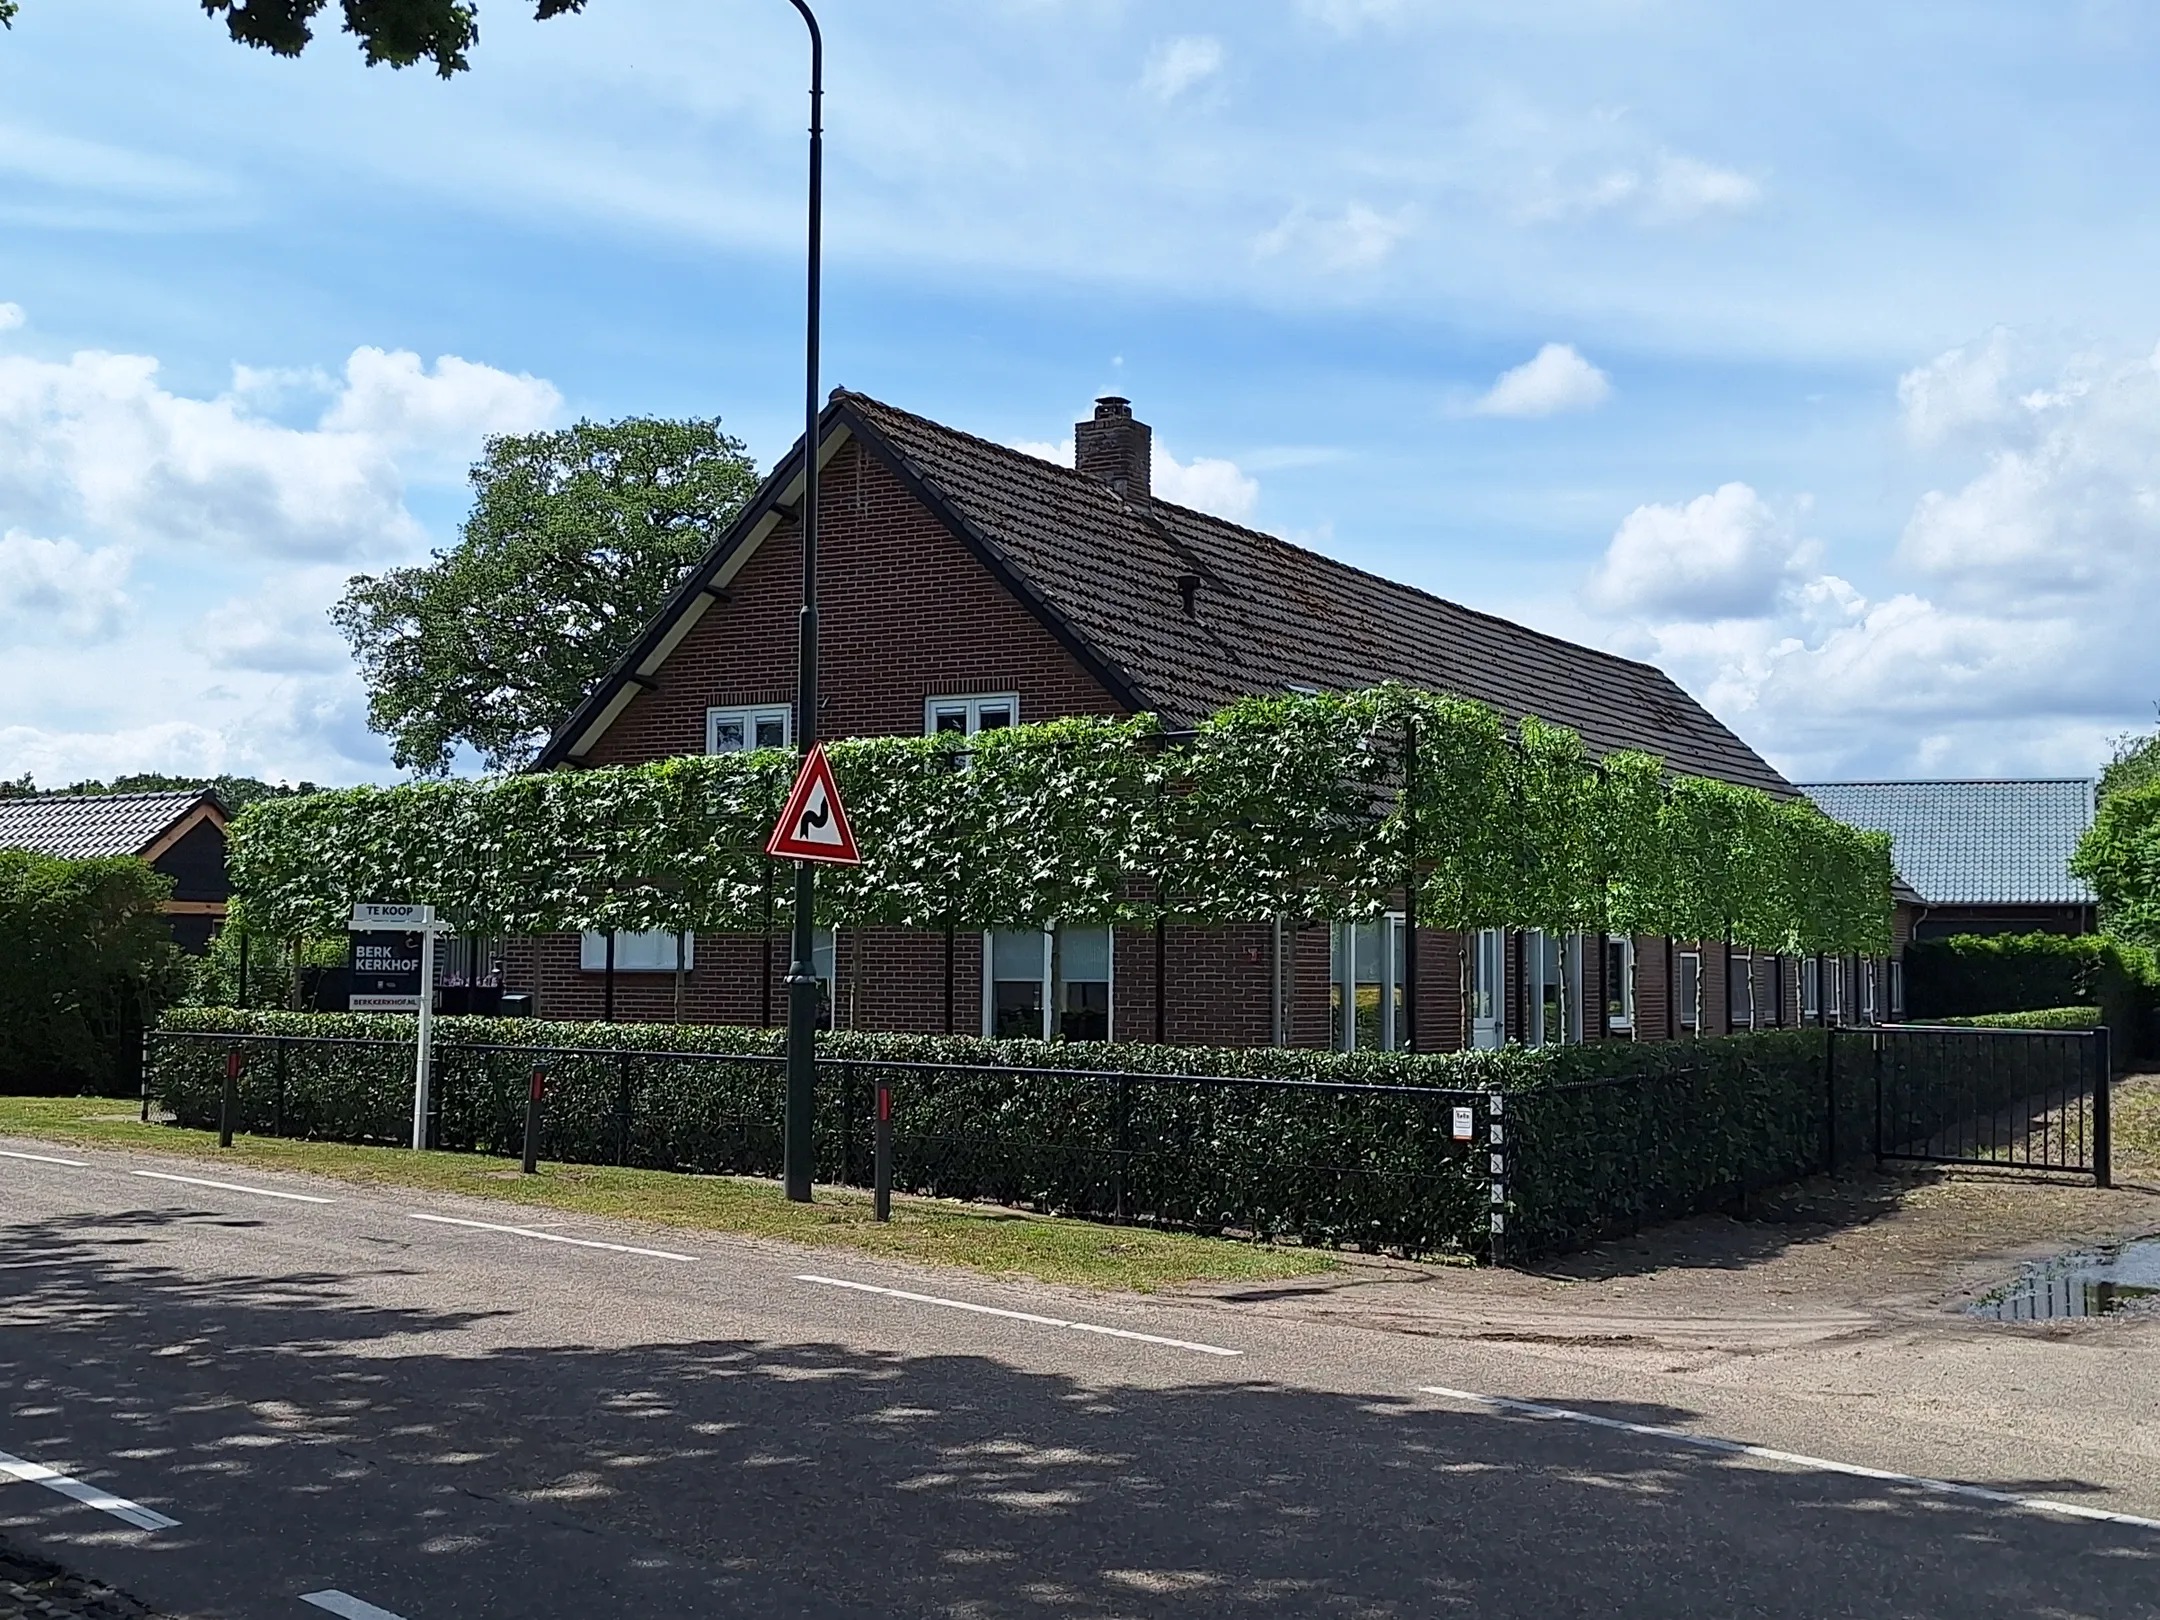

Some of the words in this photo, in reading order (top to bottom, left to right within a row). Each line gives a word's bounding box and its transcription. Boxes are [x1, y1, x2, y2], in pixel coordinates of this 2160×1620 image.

[366, 906, 380, 915] TE
[382, 906, 413, 916] KOOP
[356, 946, 392, 958] BERK
[355, 959, 419, 971] KERKHOF
